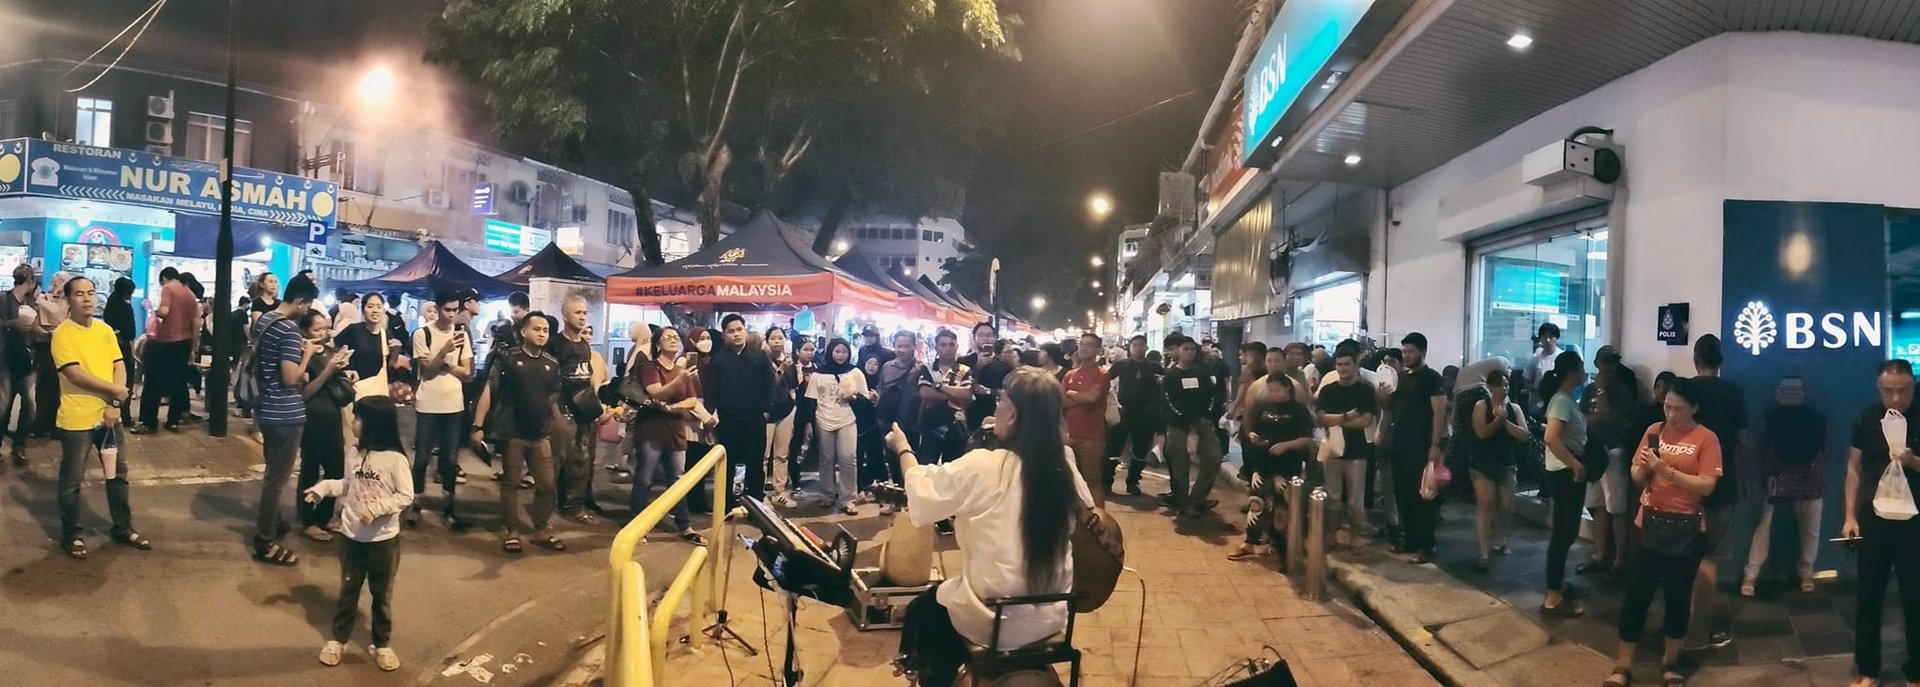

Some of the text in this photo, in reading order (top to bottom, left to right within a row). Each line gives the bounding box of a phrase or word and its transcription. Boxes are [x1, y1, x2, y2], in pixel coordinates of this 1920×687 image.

[1259, 33, 1287, 115] BSN
[53, 143, 122, 159] RESTORAN
[120, 165, 307, 211] NUR ASMAH
[309, 222, 326, 241] P
[1785, 311, 1881, 349] BSN
[1658, 439, 1695, 455] hamps
